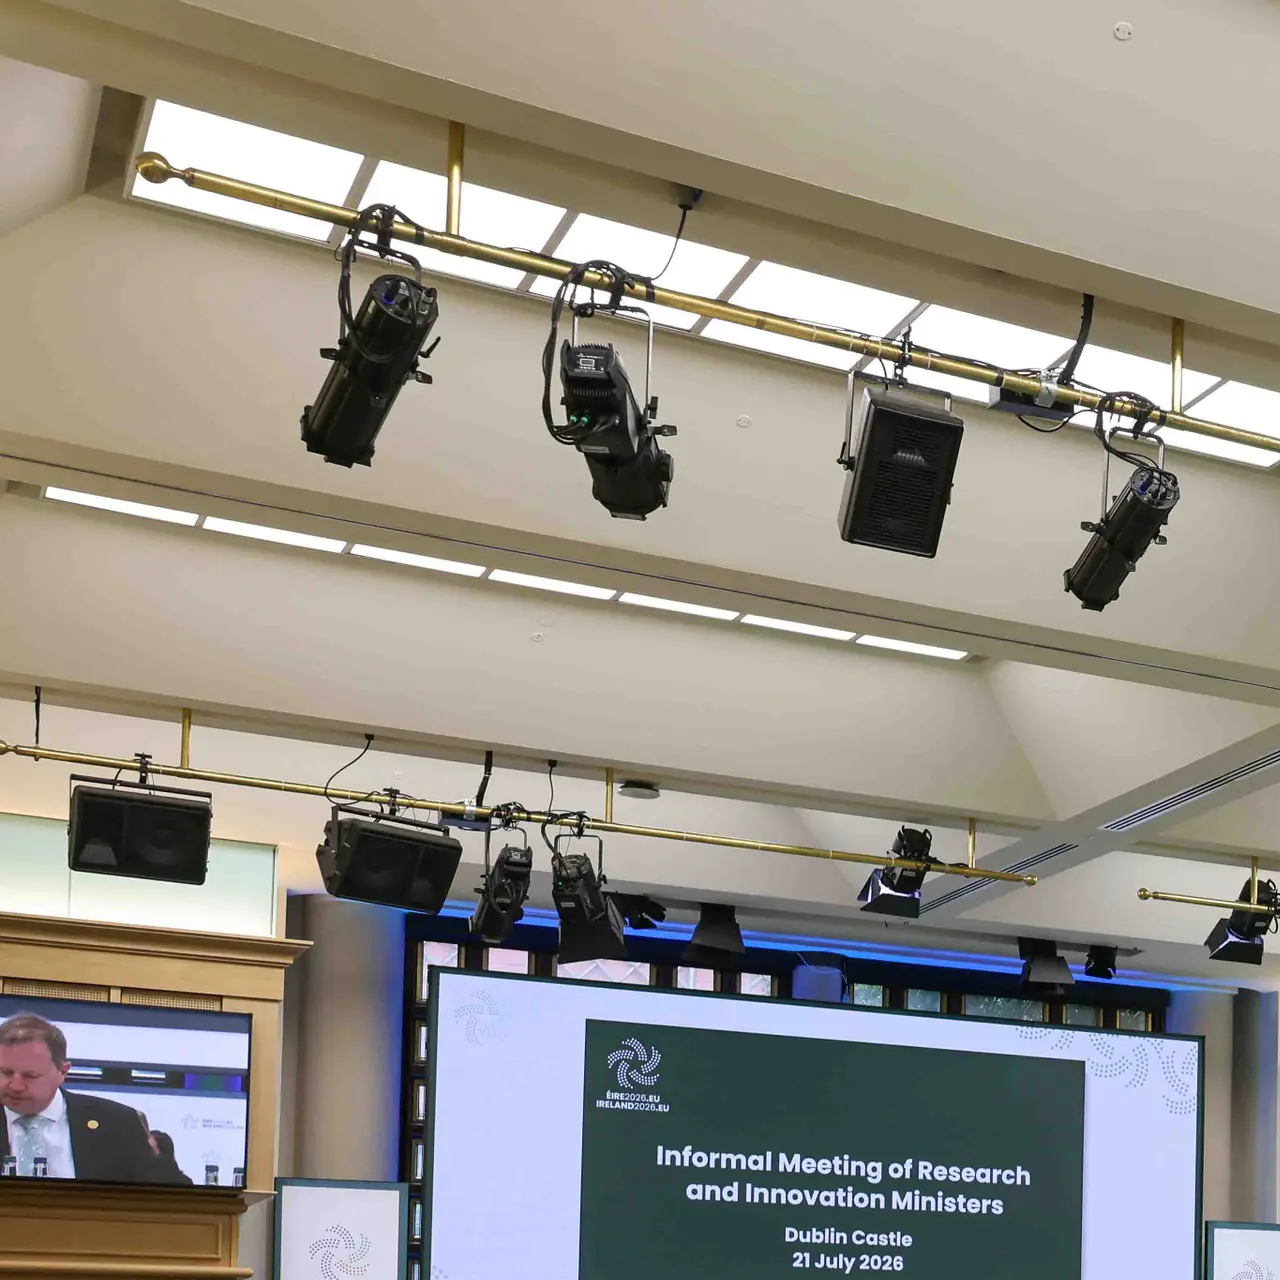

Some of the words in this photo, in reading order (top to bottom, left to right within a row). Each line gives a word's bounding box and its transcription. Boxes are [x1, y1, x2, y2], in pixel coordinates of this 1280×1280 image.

[596, 1100, 670, 1112] IRELAND2026.EU
[606, 1090, 660, 1103] ÉIRE2026.EU
[656, 1145, 772, 1172] Informal
[778, 1152, 883, 1184] Meeting
[888, 1158, 913, 1179] of
[918, 1160, 1031, 1185] Research
[686, 1182, 739, 1202] and
[745, 1183, 885, 1210] Innovation
[891, 1189, 1004, 1215] Ministers
[784, 1227, 848, 1245] Dublin
[851, 1229, 913, 1248] Castle
[792, 1252, 810, 1268] 21
[814, 1253, 855, 1274] July
[859, 1254, 904, 1271] 2026
